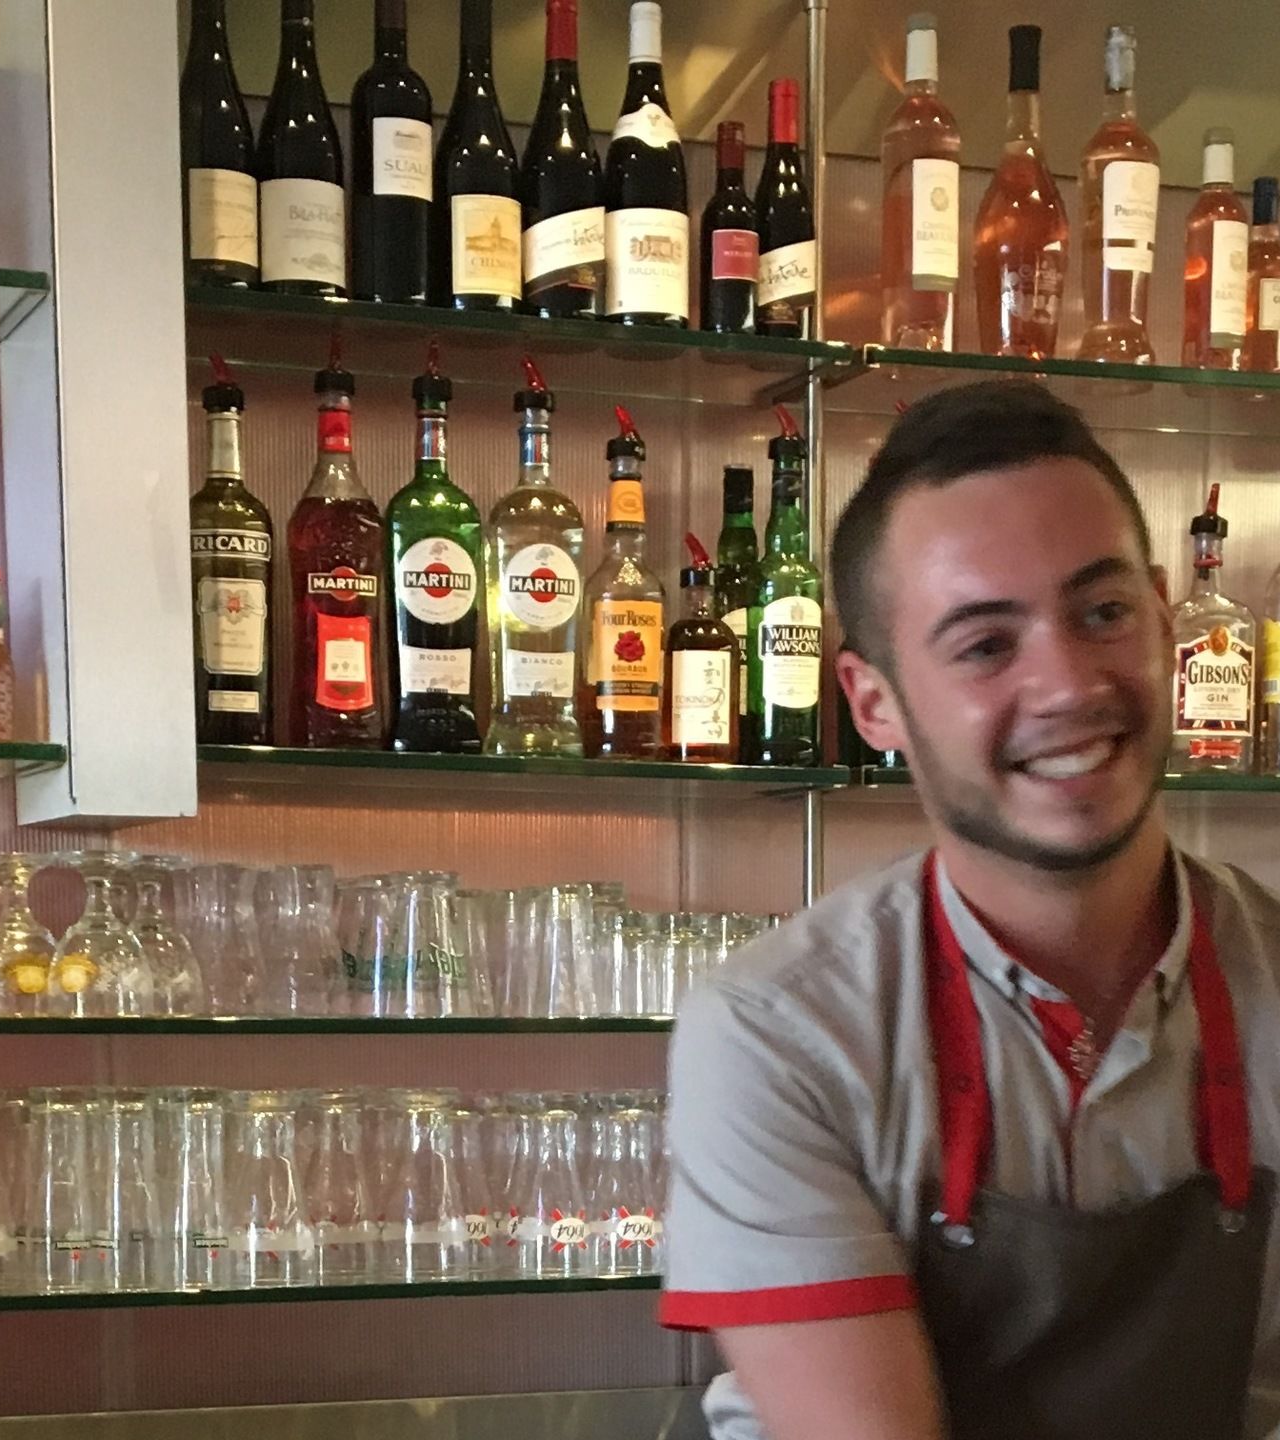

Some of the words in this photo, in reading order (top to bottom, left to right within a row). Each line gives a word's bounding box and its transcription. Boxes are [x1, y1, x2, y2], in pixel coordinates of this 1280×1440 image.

[193, 535, 268, 554] RICARD
[313, 577, 374, 592] MARTINI
[405, 573, 469, 589] MARTINI
[511, 578, 574, 594] MARTINI
[770, 628, 818, 640] WILLIAM
[420, 654, 457, 662] ROSSO
[521, 657, 564, 666] BIANCO
[1206, 694, 1229, 702] GIN
